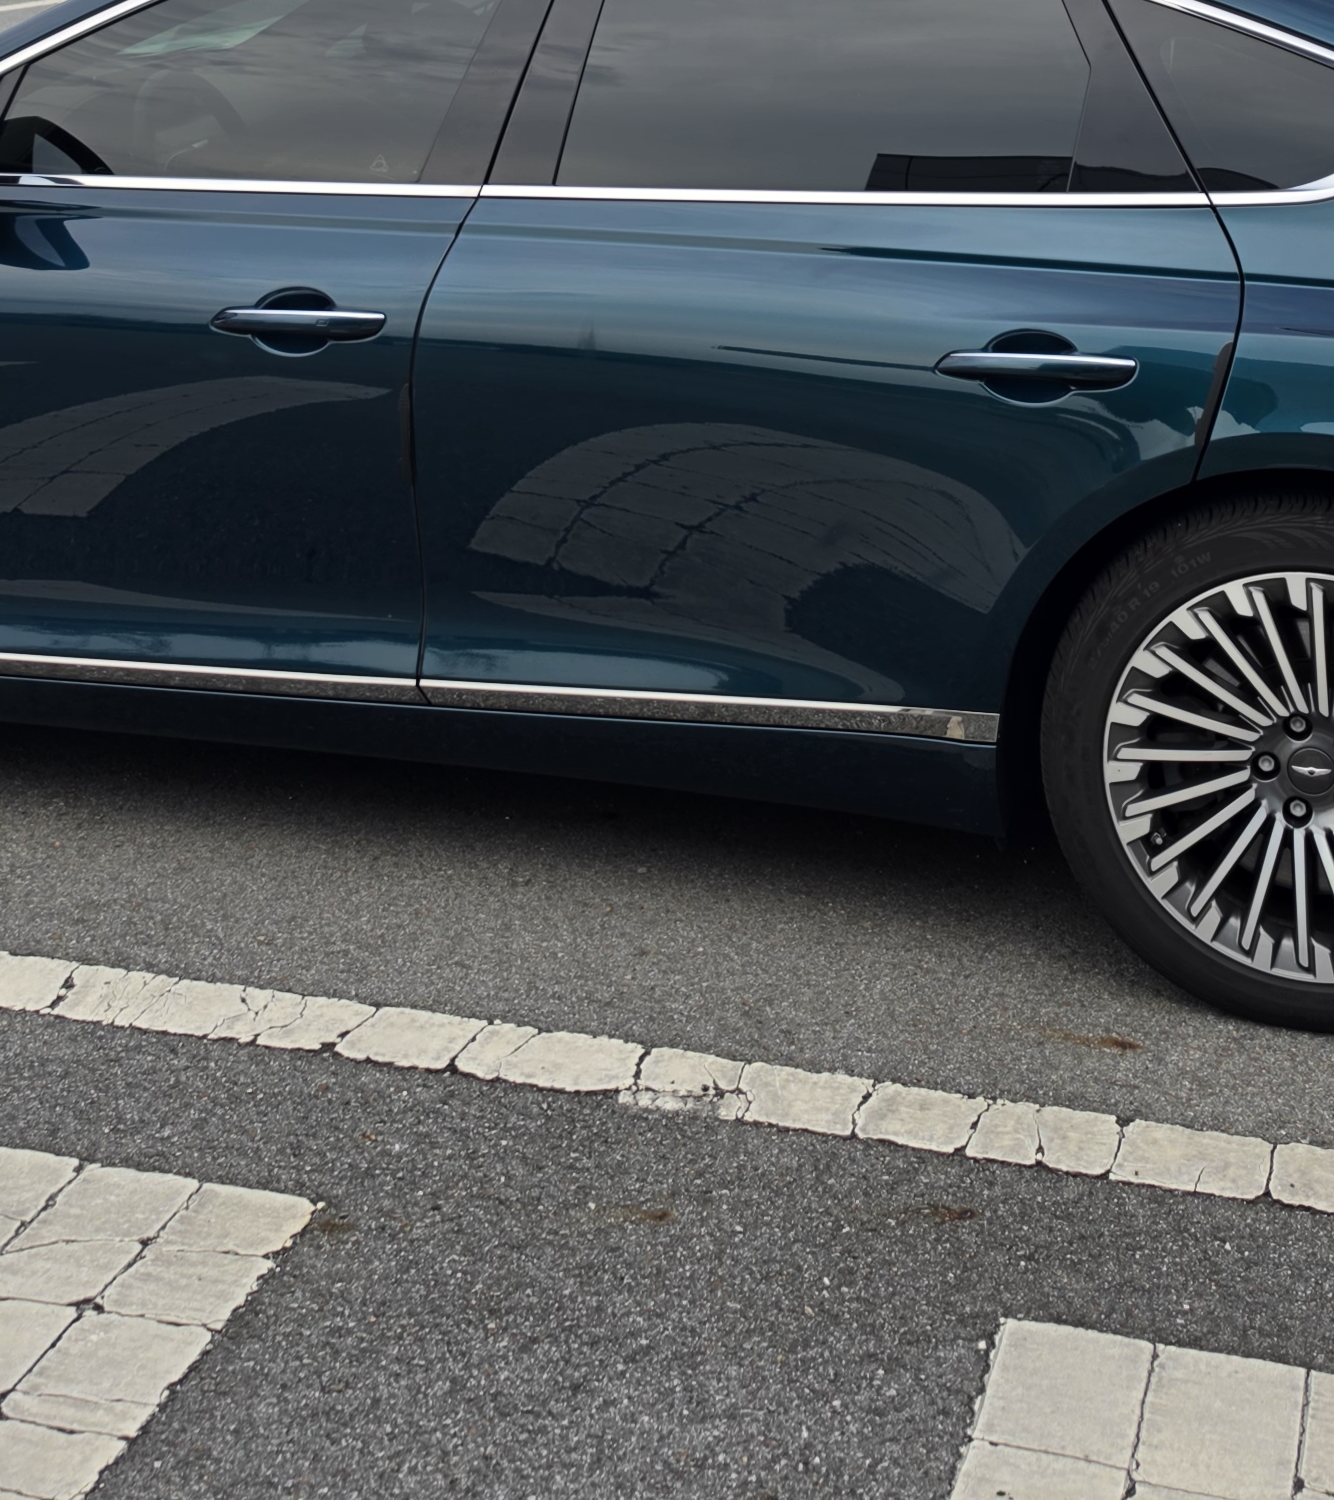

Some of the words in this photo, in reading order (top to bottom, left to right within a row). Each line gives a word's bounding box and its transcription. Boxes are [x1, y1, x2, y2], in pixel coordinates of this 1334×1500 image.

[1127, 596, 1141, 612] R
[1142, 580, 1161, 599] 19
[1169, 551, 1213, 579] 101W
